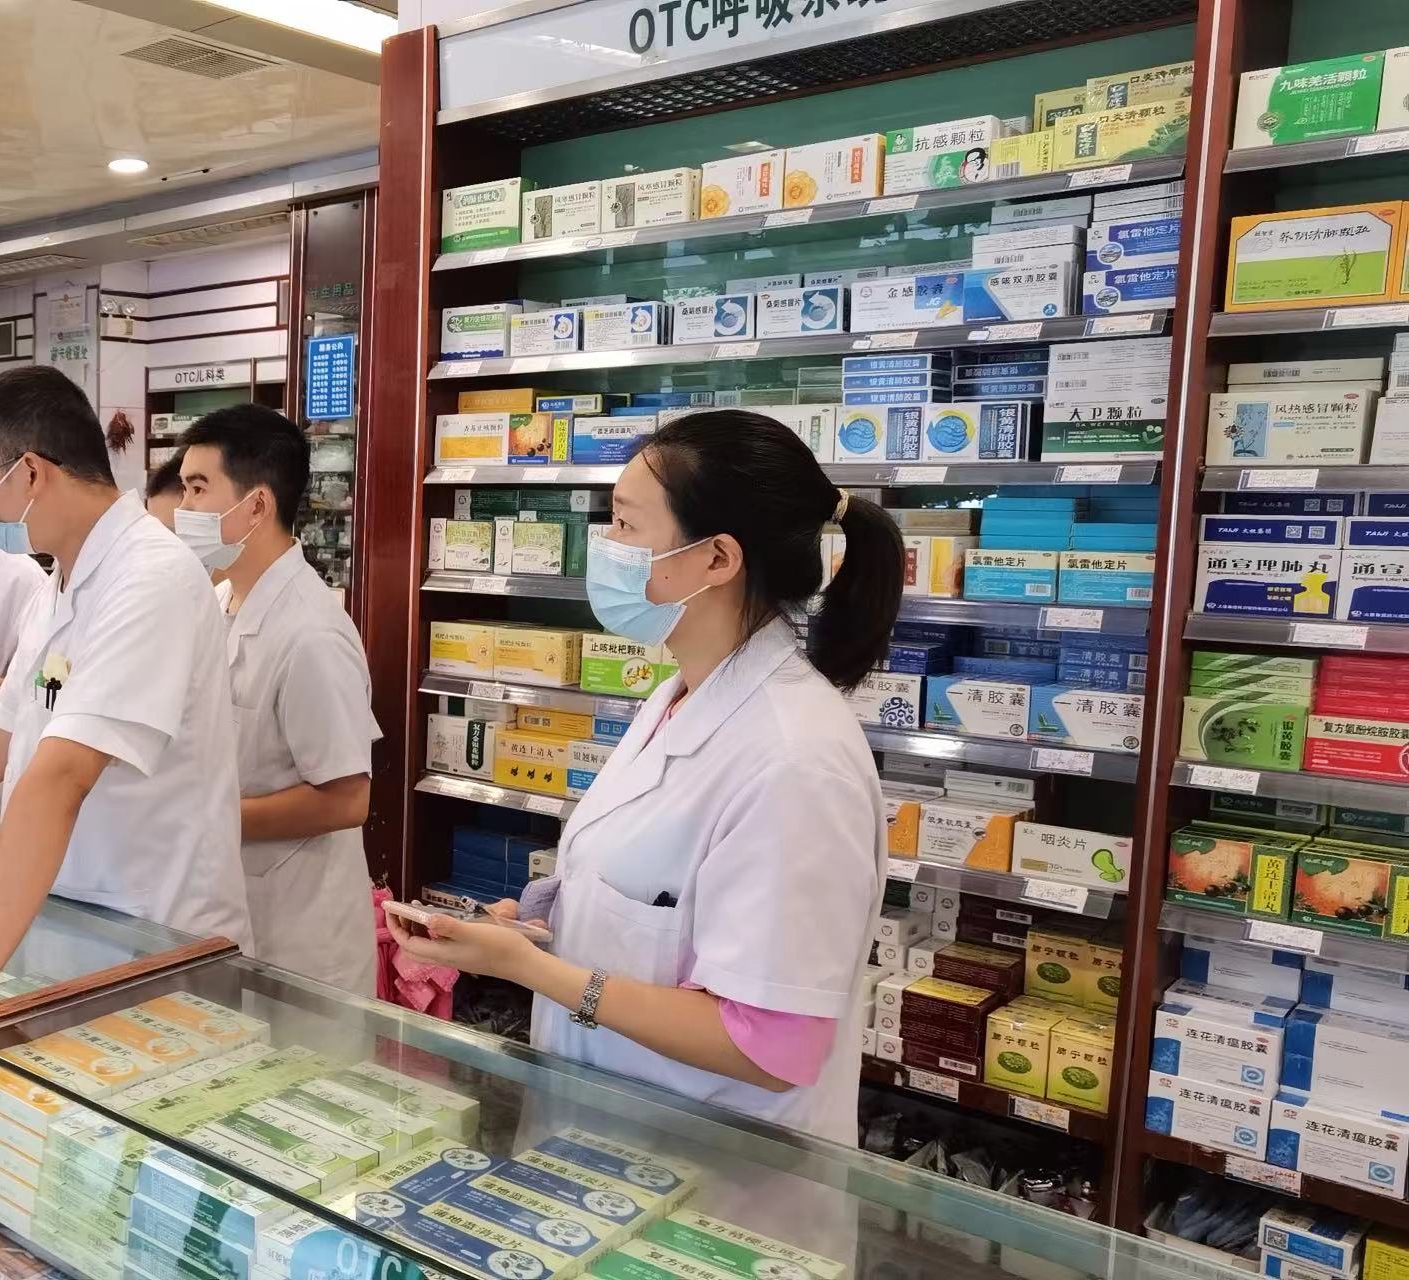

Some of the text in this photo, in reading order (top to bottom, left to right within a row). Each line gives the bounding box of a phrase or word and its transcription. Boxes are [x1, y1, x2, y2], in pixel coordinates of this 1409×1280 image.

[629, 0, 887, 54] OTC呼吸
[914, 127, 985, 151] 抗感颗粒
[175, 367, 225, 384] OTC儿科类
[1067, 557, 1128, 571] 氯雷他定片
[1206, 557, 1329, 574] 通宣理肺丸
[591, 642, 646, 657] 止咳枇杷颗粒
[948, 688, 1026, 708] 一清胶囊
[1054, 698, 1142, 718] 一清胶囊
[1041, 832, 1087, 850] 咽炎片
[1185, 1027, 1269, 1055] 连花清瘟胶囊
[1178, 1087, 1261, 1117] 连花清瘟胶囊
[1305, 1119, 1400, 1152] 连花清瘟胶囊
[336, 1237, 403, 1280] OTC
